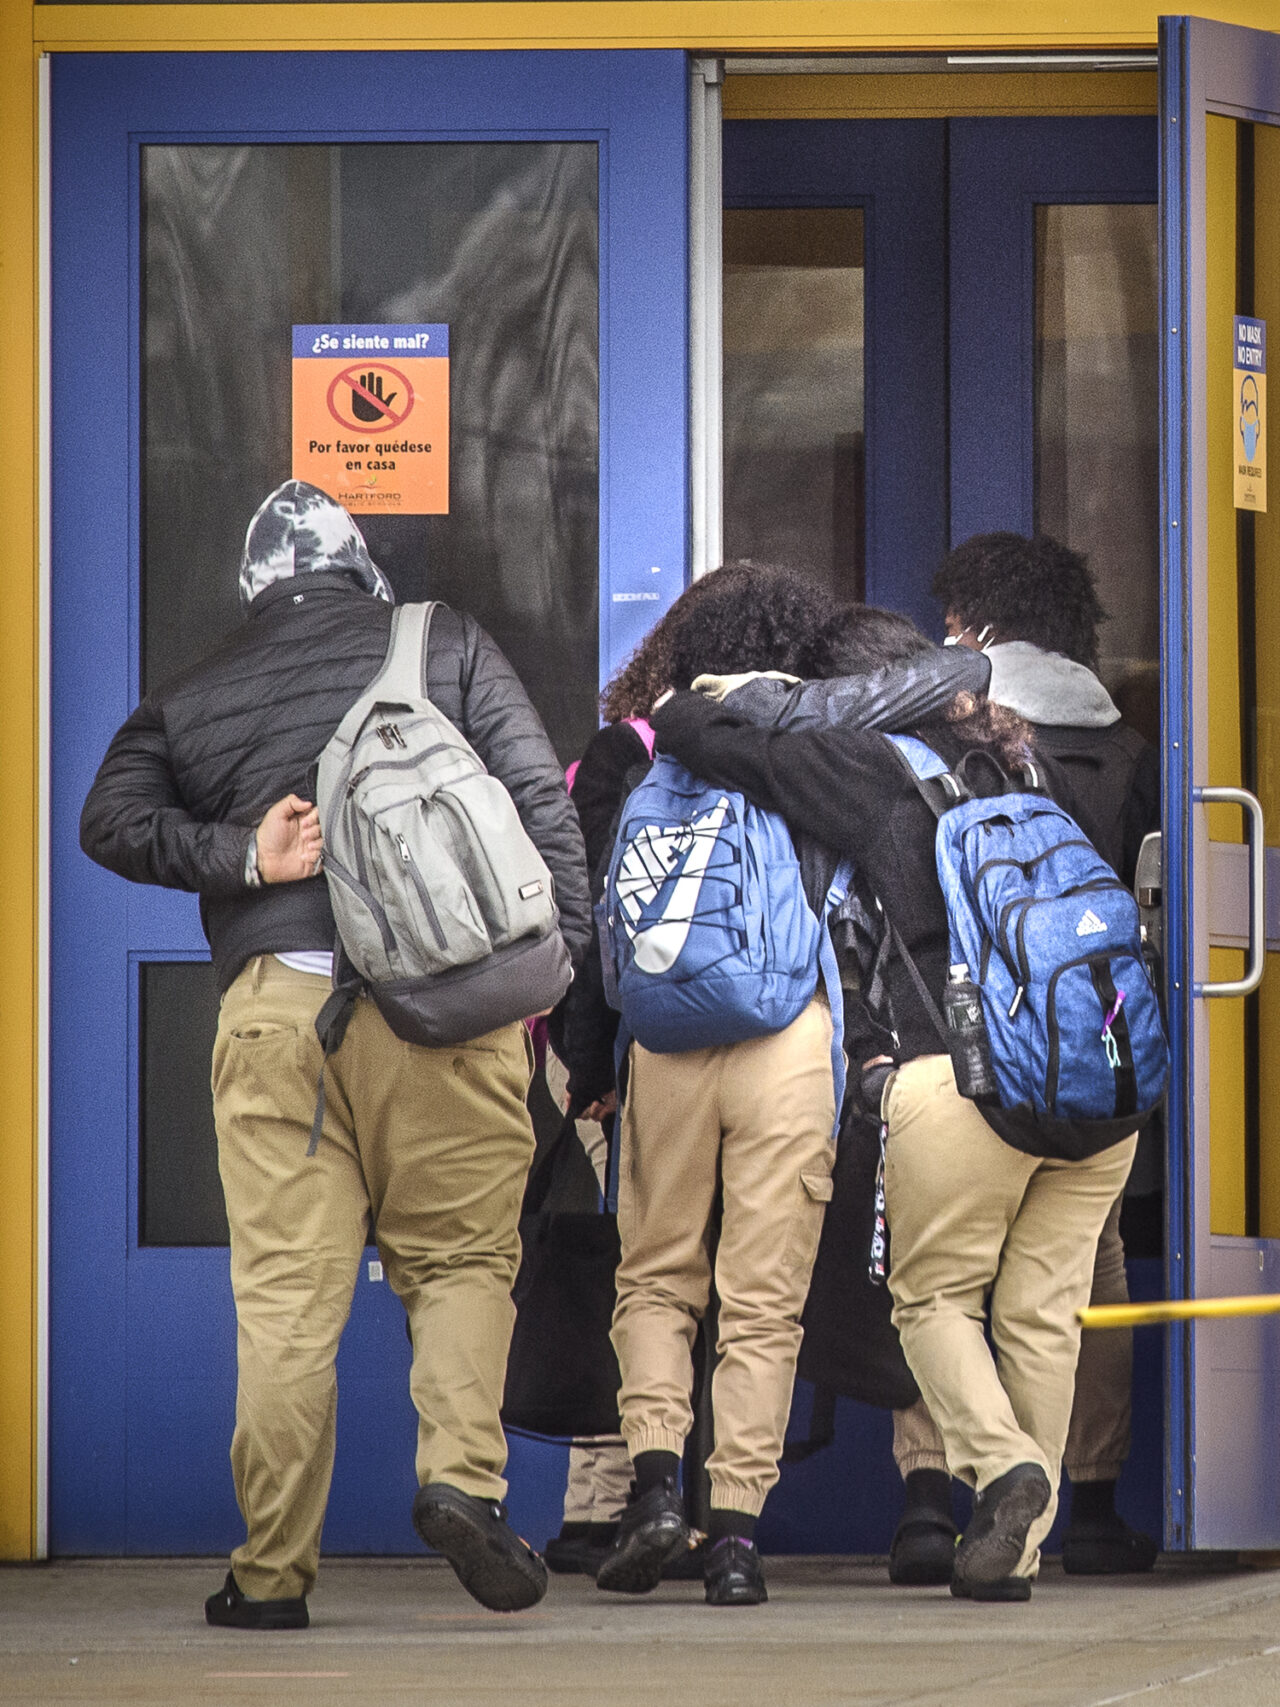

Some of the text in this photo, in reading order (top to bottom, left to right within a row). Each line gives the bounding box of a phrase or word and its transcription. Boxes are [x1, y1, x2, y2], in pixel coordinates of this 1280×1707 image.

[312, 332, 429, 352] ¿Se siente mal?
[1238, 323, 1261, 345] NO MASK
[1238, 345, 1262, 367] NO ENTRY
[309, 440, 432, 456] Por favor quédese
[346, 460, 396, 470] en casa
